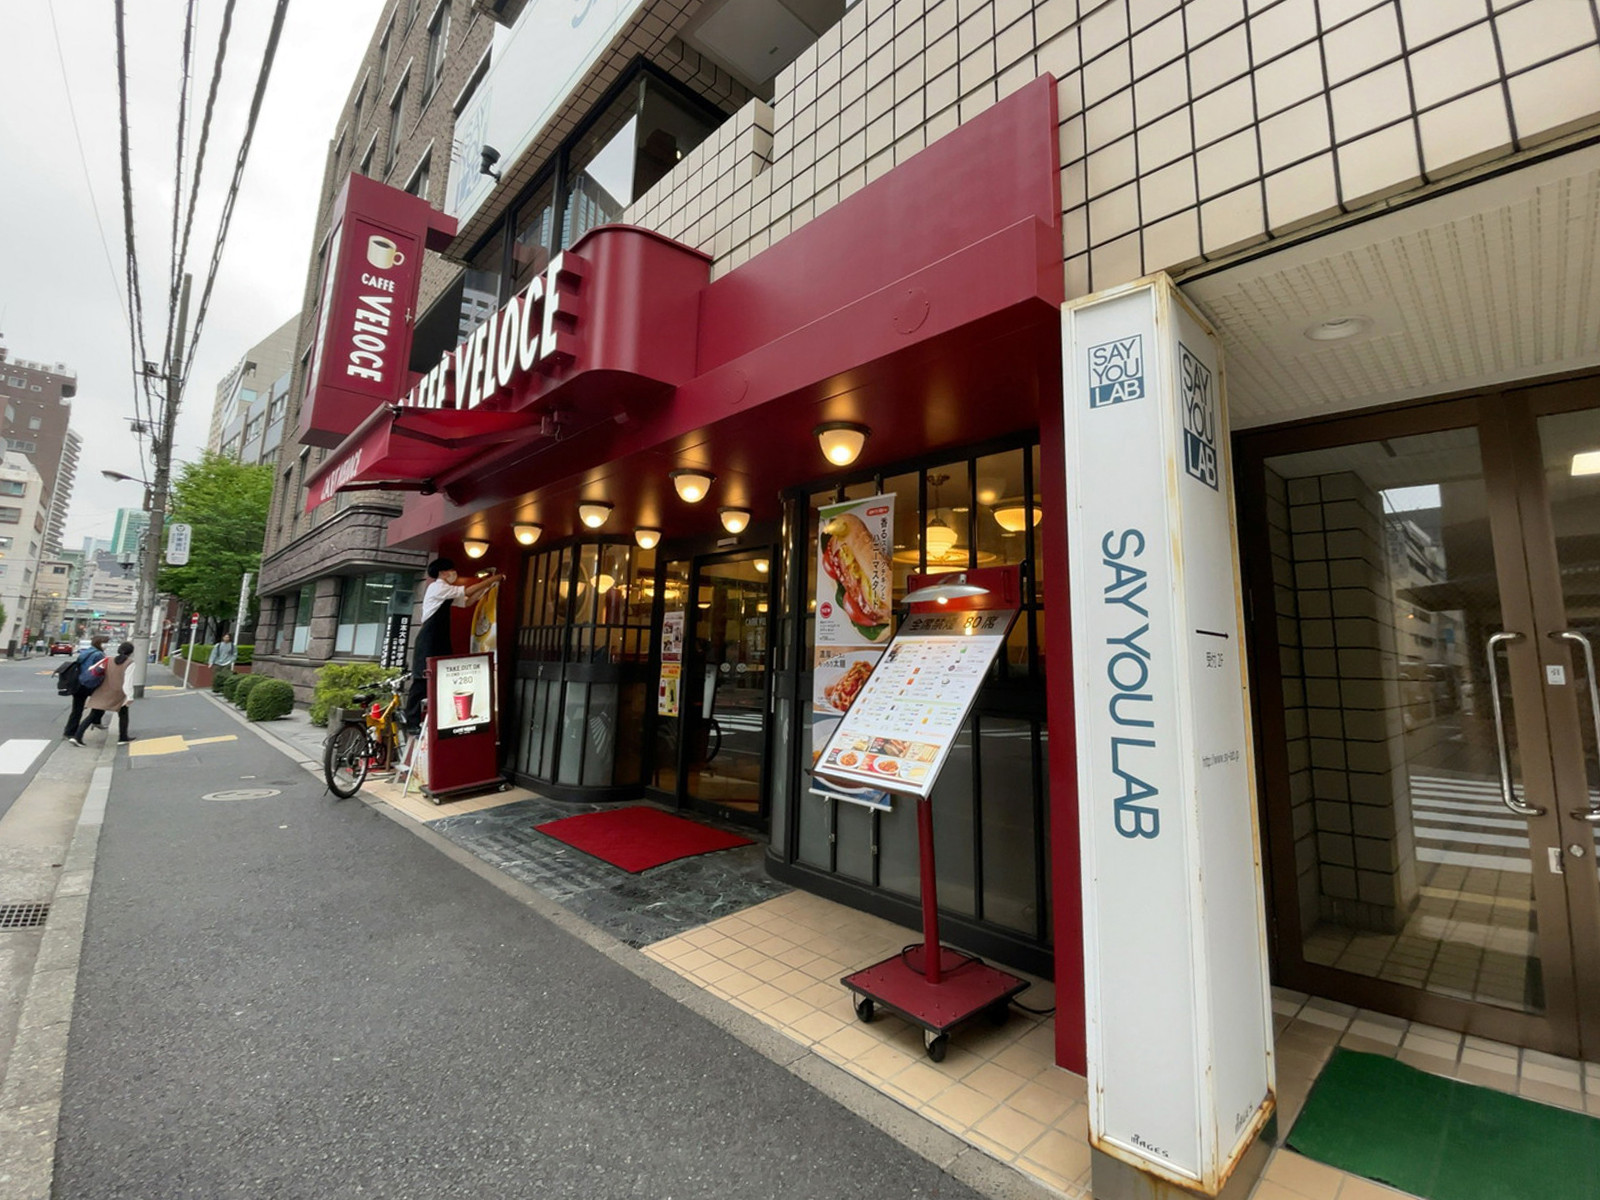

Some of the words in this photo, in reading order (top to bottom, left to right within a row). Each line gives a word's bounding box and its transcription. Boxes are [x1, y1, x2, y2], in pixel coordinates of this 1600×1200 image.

[347, 295, 393, 383] VELOCE
[455, 250, 564, 411] VELOCE
[1092, 338, 1137, 367] SAY
[1092, 357, 1140, 385] YOU
[1095, 379, 1142, 407] LAB
[1182, 353, 1209, 407] SAY
[1183, 394, 1214, 445] YOU
[1187, 432, 1217, 488] LAB
[446, 665, 460, 673] TAKE
